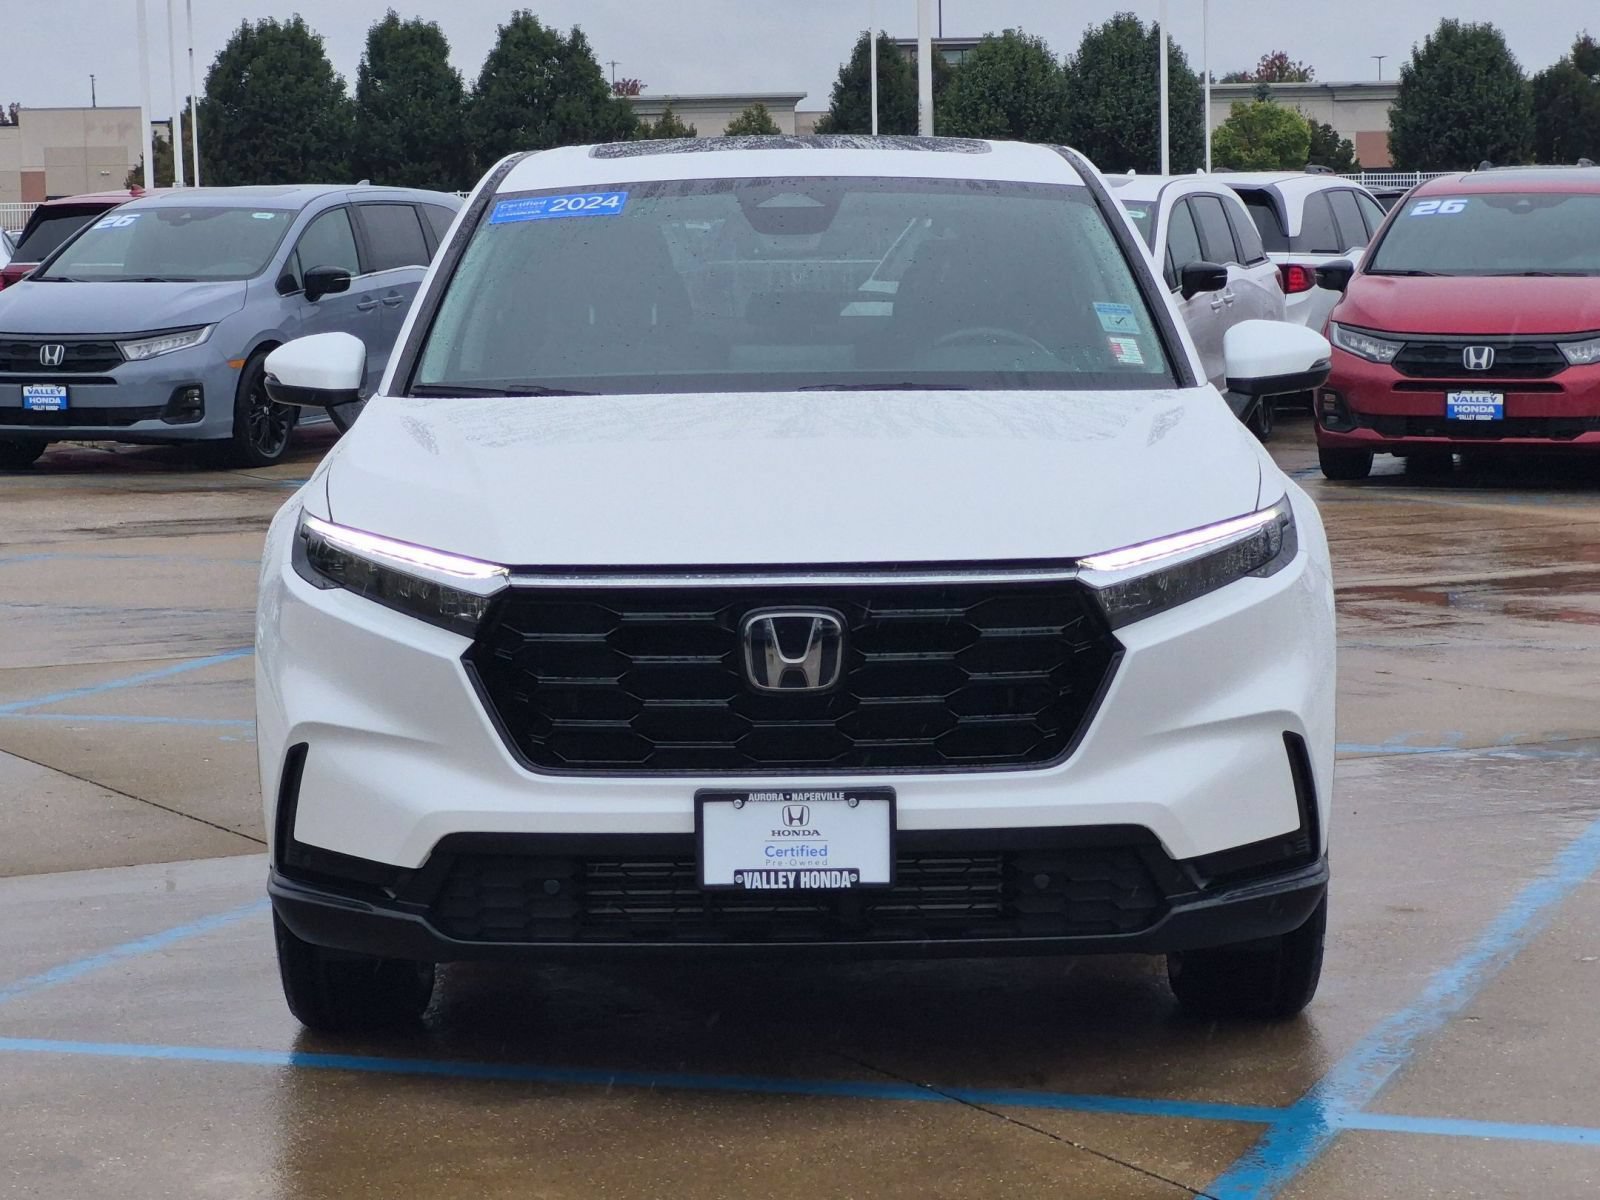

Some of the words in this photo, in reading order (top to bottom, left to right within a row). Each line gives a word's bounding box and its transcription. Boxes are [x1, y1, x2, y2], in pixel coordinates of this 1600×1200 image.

[548, 195, 620, 212] 2024
[1410, 199, 1468, 216] 26
[1453, 405, 1495, 413] HONDA
[748, 793, 784, 802] AURORA
[791, 791, 845, 802] NAPERVILLE
[771, 829, 821, 837] HONDA
[764, 844, 828, 858] Certified
[765, 858, 828, 867] Pre-Owned
[743, 871, 796, 890] VALLEY
[800, 870, 851, 889] HONDA
